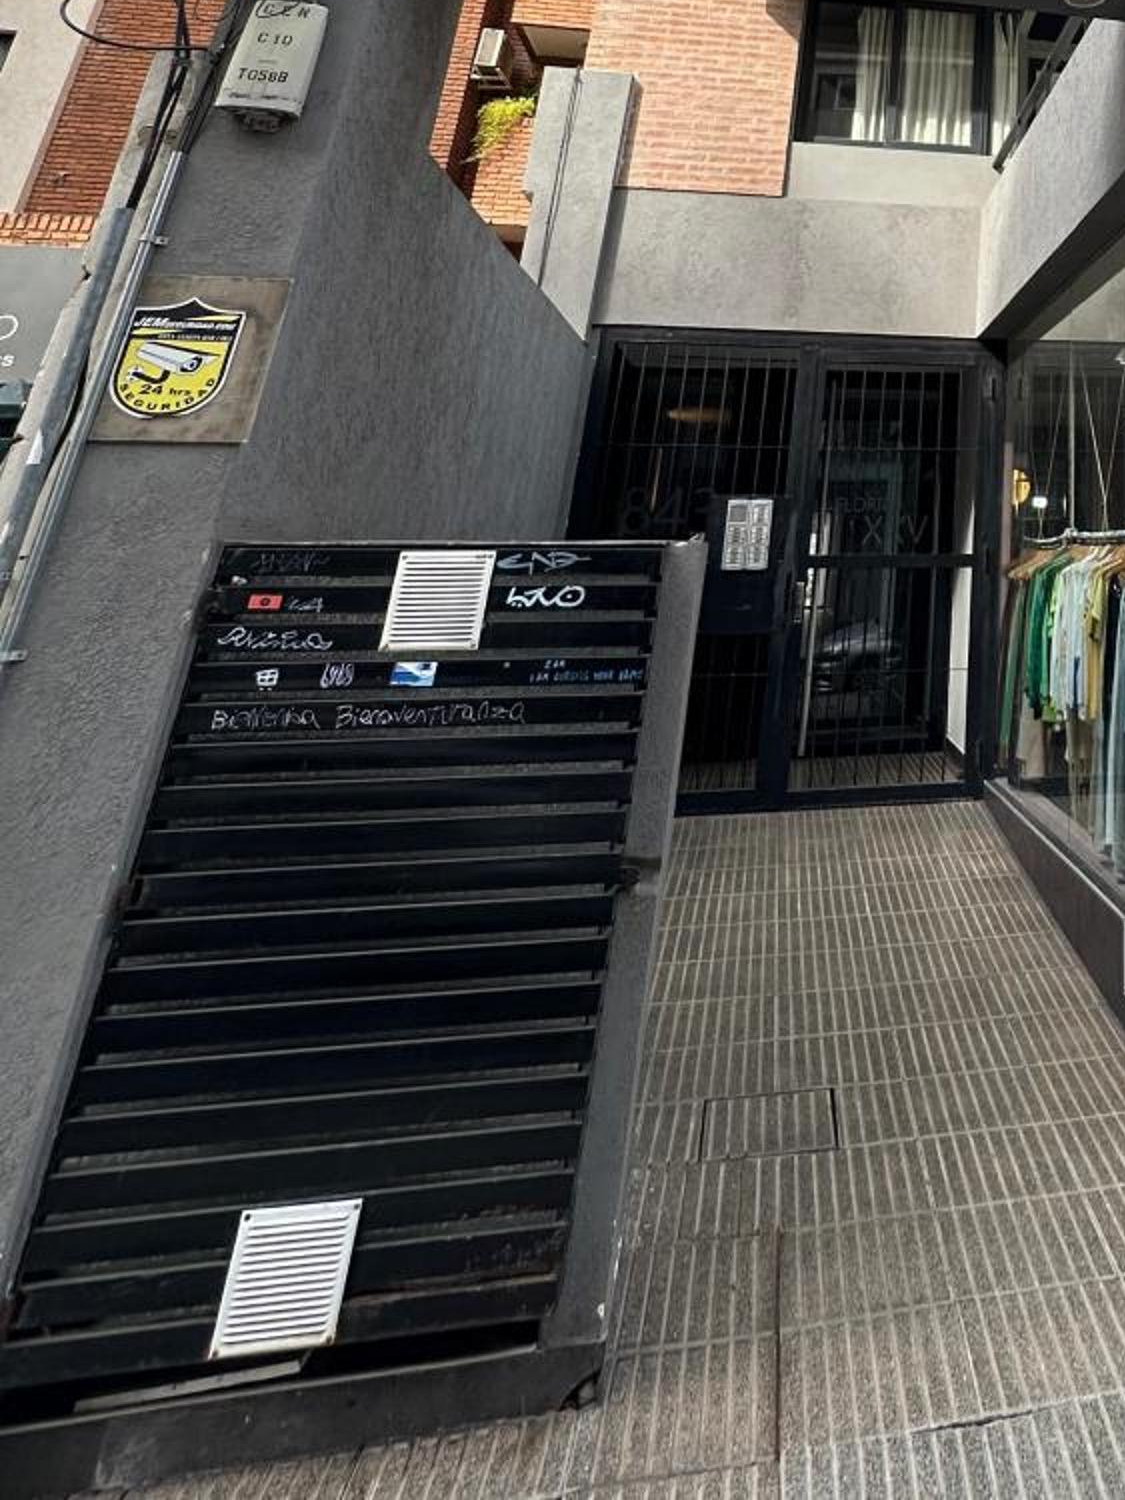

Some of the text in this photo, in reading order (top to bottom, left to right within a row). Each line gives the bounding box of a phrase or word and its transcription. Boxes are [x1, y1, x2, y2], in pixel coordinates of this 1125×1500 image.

[119, 378, 215, 411] SEGURIDAD
[138, 383, 191, 396] 24 hrs
